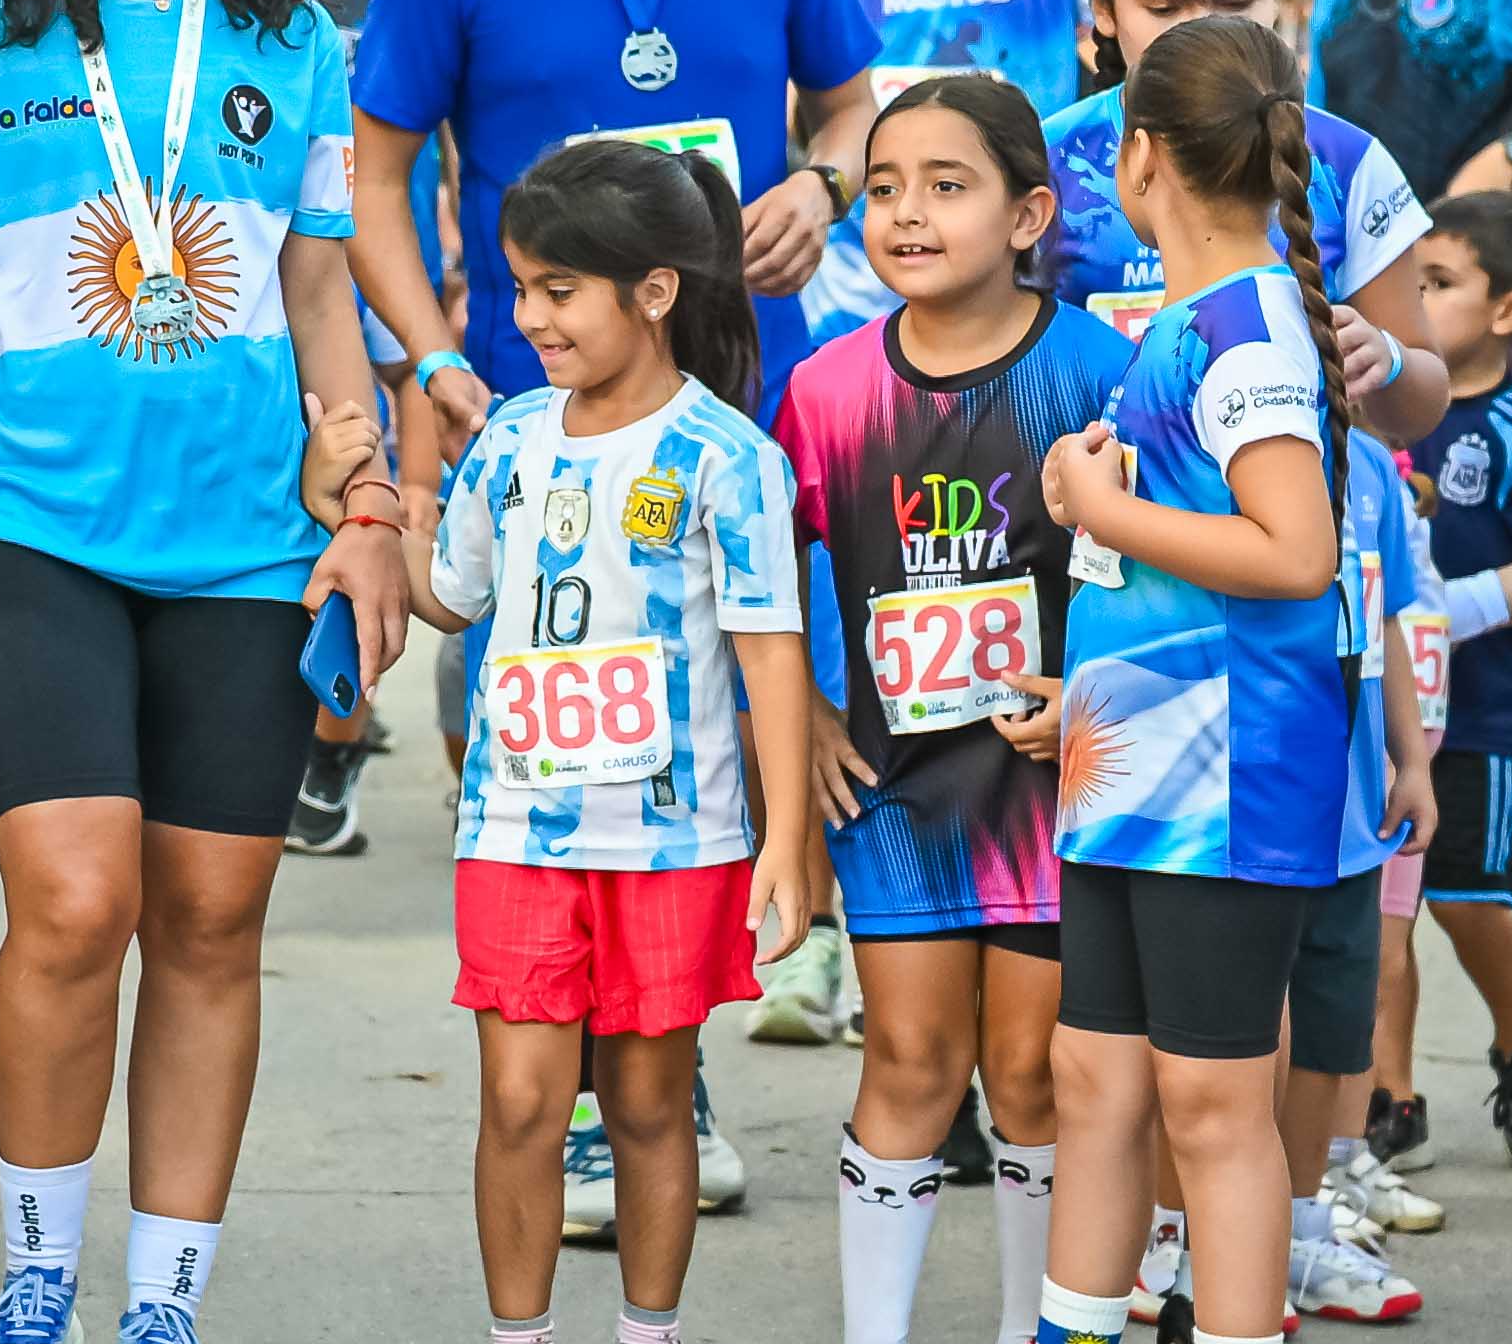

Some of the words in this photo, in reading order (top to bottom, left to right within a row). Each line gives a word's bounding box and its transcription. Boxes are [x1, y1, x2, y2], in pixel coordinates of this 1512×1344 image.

[218, 142, 240, 159] HOY
[633, 497, 667, 528] AFA
[892, 471, 1012, 548] KIDS
[901, 529, 1011, 574] OLIVA
[531, 573, 593, 648] 10
[875, 597, 1026, 698] 528
[497, 655, 656, 753] 368
[602, 753, 658, 771] CARUSO
